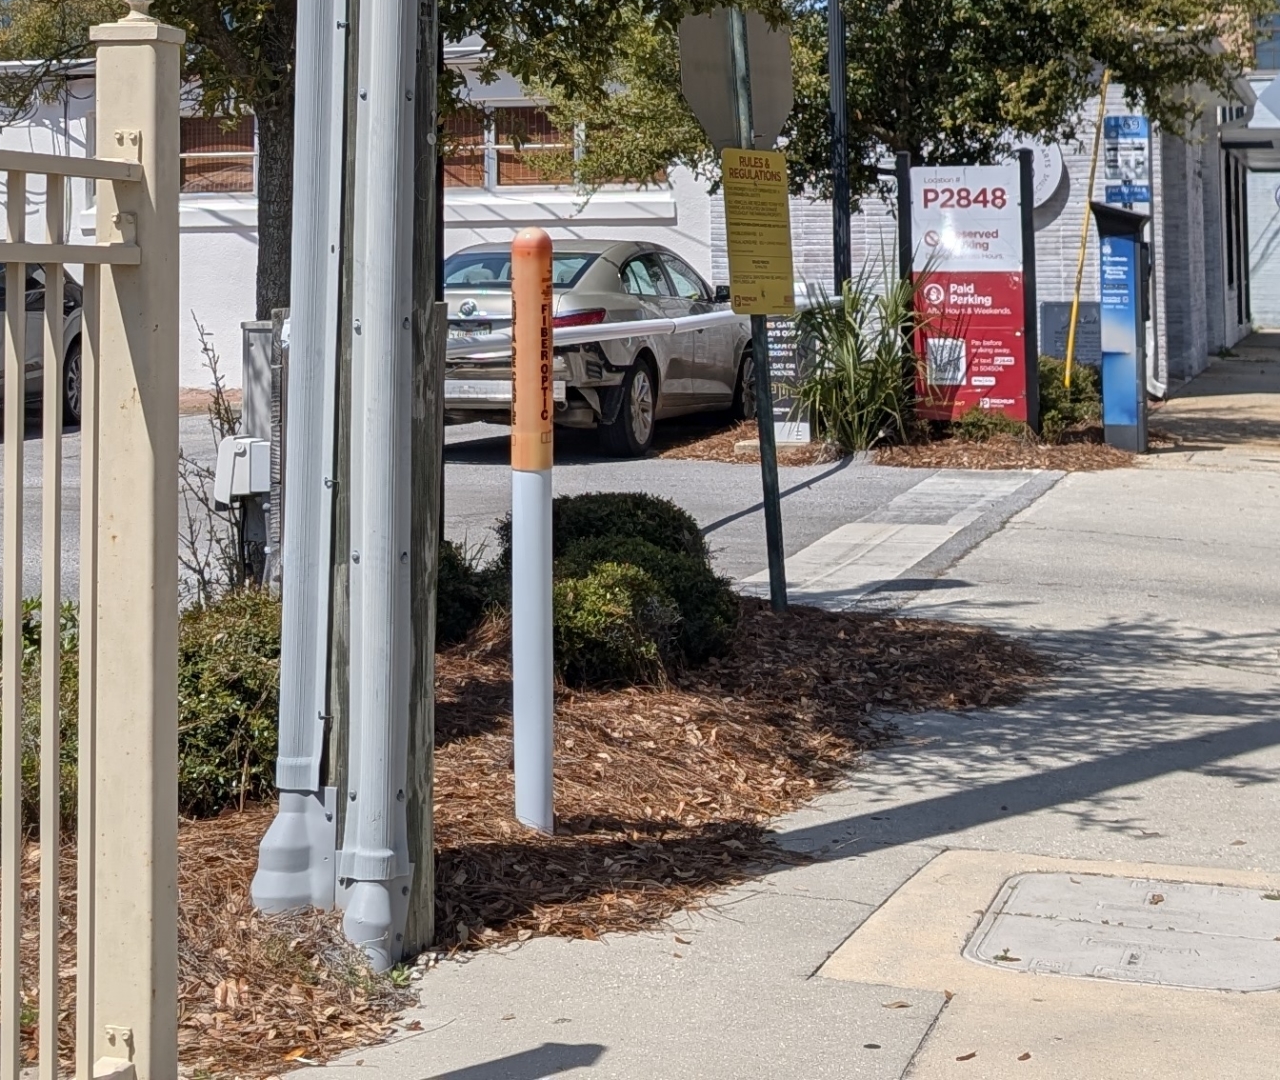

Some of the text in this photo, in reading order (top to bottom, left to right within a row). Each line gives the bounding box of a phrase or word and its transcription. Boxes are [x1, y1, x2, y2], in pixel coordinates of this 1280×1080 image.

[738, 156, 770, 169] RULES &
[728, 167, 782, 182] REGULATIONS
[923, 187, 1007, 210] P2848
[950, 283, 974, 294] Paid
[950, 295, 992, 306] Parking
[974, 307, 1012, 315] Weekends.
[540, 304, 548, 361] FIBER
[540, 363, 549, 421] OPTIC
